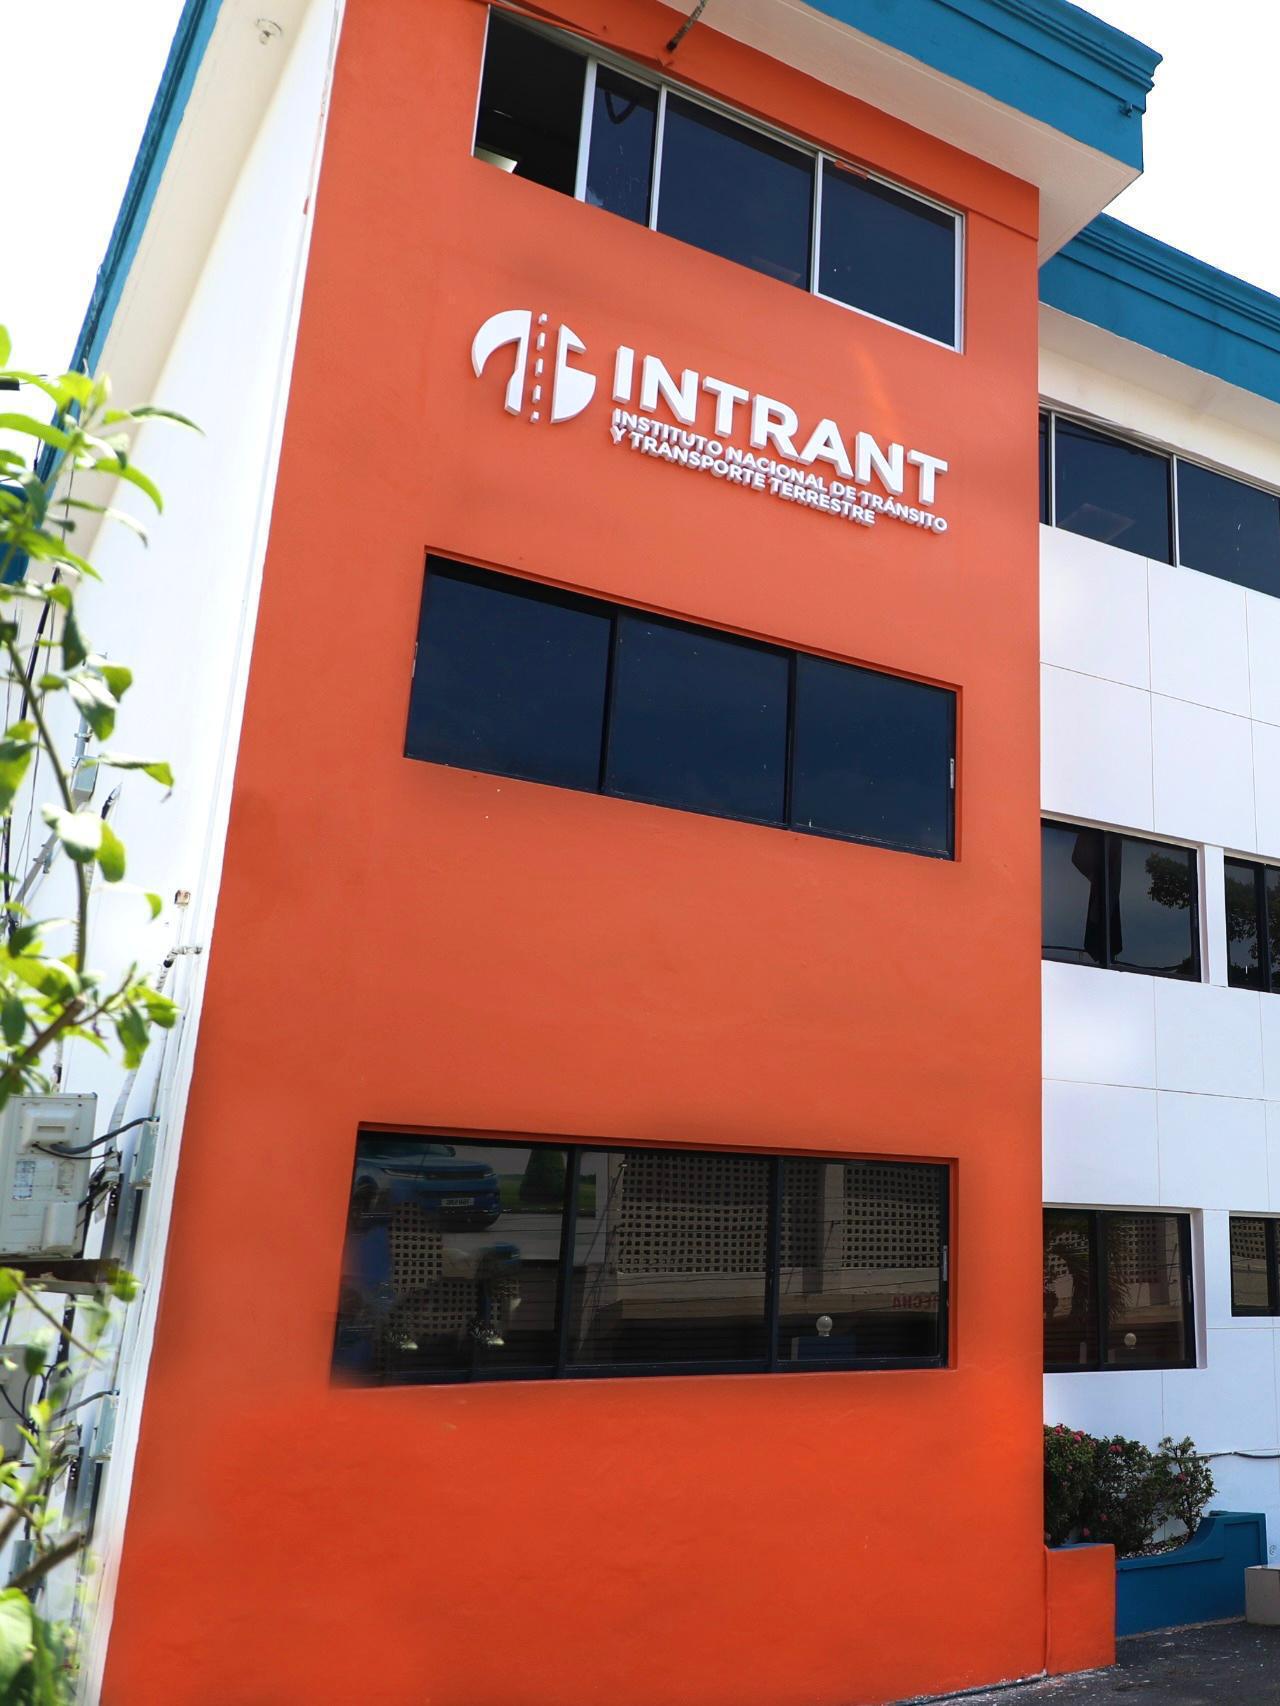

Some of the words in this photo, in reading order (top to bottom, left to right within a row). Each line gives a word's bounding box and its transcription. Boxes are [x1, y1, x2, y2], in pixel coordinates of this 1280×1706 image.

[610, 425, 626, 445] Y
[629, 431, 766, 491] TRANSPORTE
[767, 476, 876, 528] TERRESTRE
[612, 345, 949, 508] INTRANT
[612, 408, 723, 459] INSTITUTO
[724, 446, 828, 495] NACIONAL
[829, 481, 857, 503] DE
[857, 490, 949, 534] TRÁNSITO
